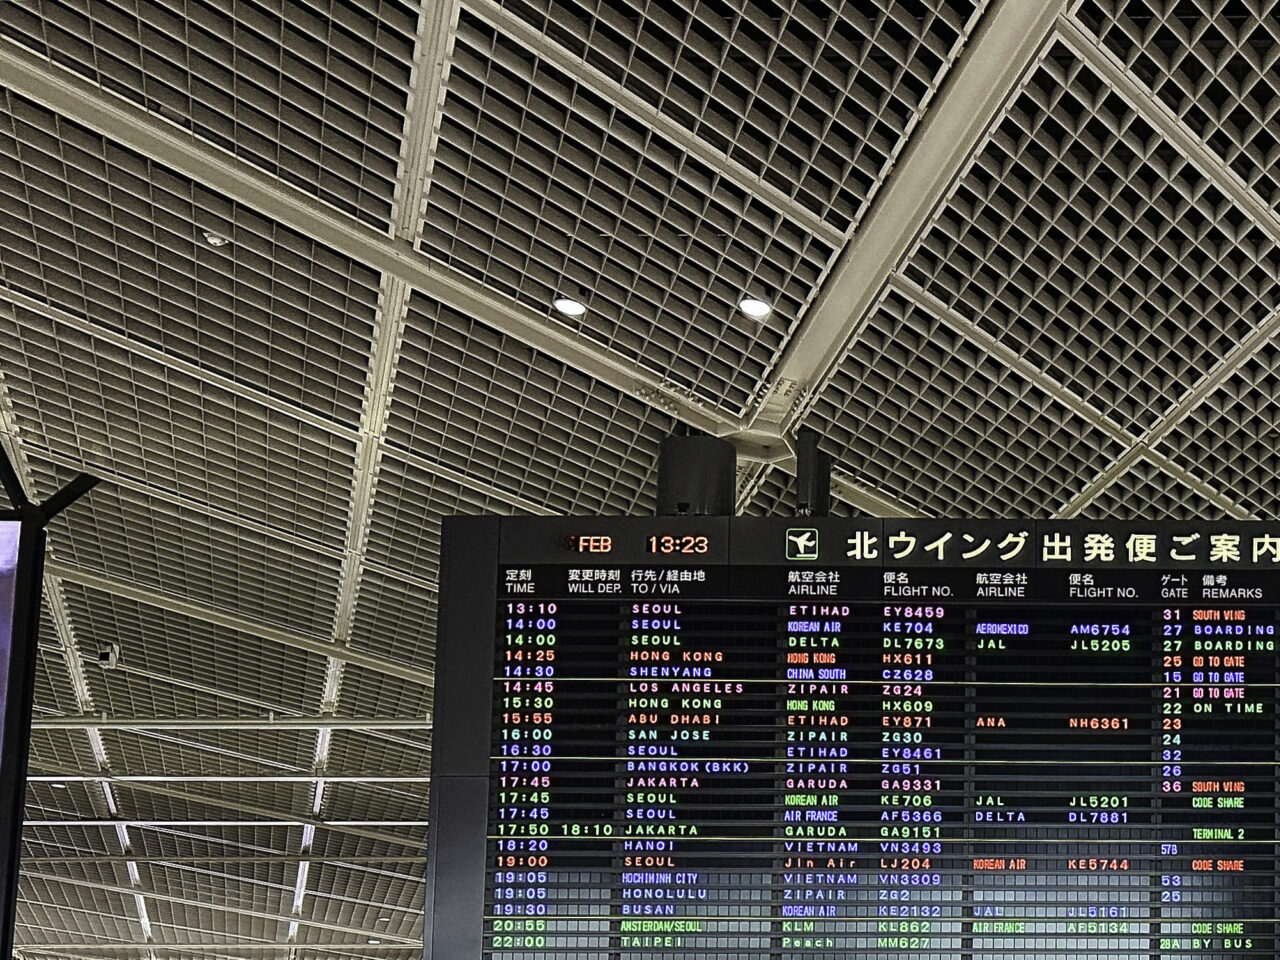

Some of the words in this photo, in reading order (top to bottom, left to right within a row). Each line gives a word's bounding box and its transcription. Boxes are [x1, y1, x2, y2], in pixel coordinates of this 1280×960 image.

[579, 536, 612, 552] FEB
[649, 536, 708, 553] 13:23
[506, 570, 531, 581] 定刻
[568, 570, 620, 581] 変更時刻
[631, 570, 705, 582] 行先/経由地
[788, 571, 840, 583] 航空会社
[884, 572, 908, 584] 便名
[976, 573, 1027, 585] 航空会社
[1069, 573, 1094, 585] 便名
[1161, 575, 1187, 585] ゲート
[1203, 575, 1226, 586] 備考
[506, 584, 534, 593] TIME
[568, 584, 594, 594] WILL
[597, 584, 622, 594] DEP.
[789, 585, 837, 595] AIRLINE
[884, 586, 928, 597] FLIGHT
[932, 586, 953, 597] NO.
[977, 587, 1024, 597] AIRLINE
[1070, 587, 1113, 597] FLIGHT
[1117, 587, 1138, 598] NO.
[1162, 588, 1188, 598] GATE
[1203, 588, 1262, 599] REMARKS
[508, 604, 556, 614] 13:10
[633, 604, 680, 613] SEOUL
[790, 606, 849, 615] ETIHAD
[884, 607, 944, 617] EY8459
[1164, 609, 1179, 620] 31
[1193, 610, 1220, 620] SOUTH
[1223, 610, 1245, 620] WING
[507, 619, 556, 629] 14:00
[632, 620, 680, 629] SEOUL
[788, 621, 820, 632] KOREAN
[824, 622, 841, 632] AIR
[883, 622, 933, 633] KE704
[631, 673, 647, 683] TO
[659, 584, 679, 594] VIA
[1071, 624, 1129, 635] AM6754
[1164, 625, 1182, 635] 27
[1194, 625, 1274, 634] BOARDING
[507, 635, 555, 645] 14:00
[632, 635, 680, 645] SEOUL
[789, 637, 839, 646] DELTA
[884, 638, 944, 649] DL7673
[978, 640, 1005, 649] JAL
[1071, 640, 1130, 651] JL5205
[1164, 641, 1181, 651] 27
[1195, 641, 1273, 650] BOARDING
[505, 666, 554, 677] 14:30
[630, 667, 711, 677] SHENYANG
[787, 669, 814, 679] CHINA
[818, 669, 846, 679] SOUTH
[883, 670, 933, 682] CZ628
[1164, 672, 1181, 683] 15
[1193, 673, 1204, 683] GO
[1208, 673, 1219, 683] TO
[1224, 673, 1244, 683] GATE
[504, 697, 553, 708] 15:30
[629, 699, 668, 708] HONG
[682, 699, 721, 708] KONG
[787, 700, 808, 710] HONG
[813, 700, 835, 711] KONG
[883, 701, 932, 712] HX609
[1164, 703, 1181, 714] 22
[1194, 704, 1212, 714] ON
[1225, 704, 1262, 713] TIME
[504, 713, 552, 723] 15:55
[629, 714, 657, 723] ABU
[671, 715, 721, 724] DHABI
[788, 716, 848, 725] ETIHAD
[883, 717, 930, 727] EY871
[977, 718, 1005, 726] ANA
[1070, 718, 1127, 729] NH6361
[1163, 719, 1181, 729] 23
[501, 761, 551, 771] 17:00
[628, 762, 698, 771] BANGKOK
[705, 762, 748, 772] (BKK)
[787, 762, 847, 772] ZIPAIR
[882, 764, 919, 774] ZG51
[1163, 766, 1181, 776] 26
[499, 824, 548, 836] 17:50
[562, 825, 612, 836] 18:10
[626, 826, 697, 835] JAKARTA
[786, 827, 846, 836] GARUDA
[881, 827, 939, 837] GA9151
[1193, 829, 1233, 838] TERMINAL
[1238, 829, 1244, 839] 2
[494, 888, 546, 899] 19:05
[622, 889, 706, 899] HONOLULU
[784, 889, 845, 900] ZIPAIR
[879, 890, 909, 901] ZG2
[1162, 891, 1180, 902] 25
[492, 937, 544, 947] 22:00
[621, 937, 682, 948] TAIPEI
[782, 938, 833, 949] Peach
[879, 939, 929, 950] MM627
[1193, 940, 1211, 951] BY
[1224, 940, 1252, 951] BUS
